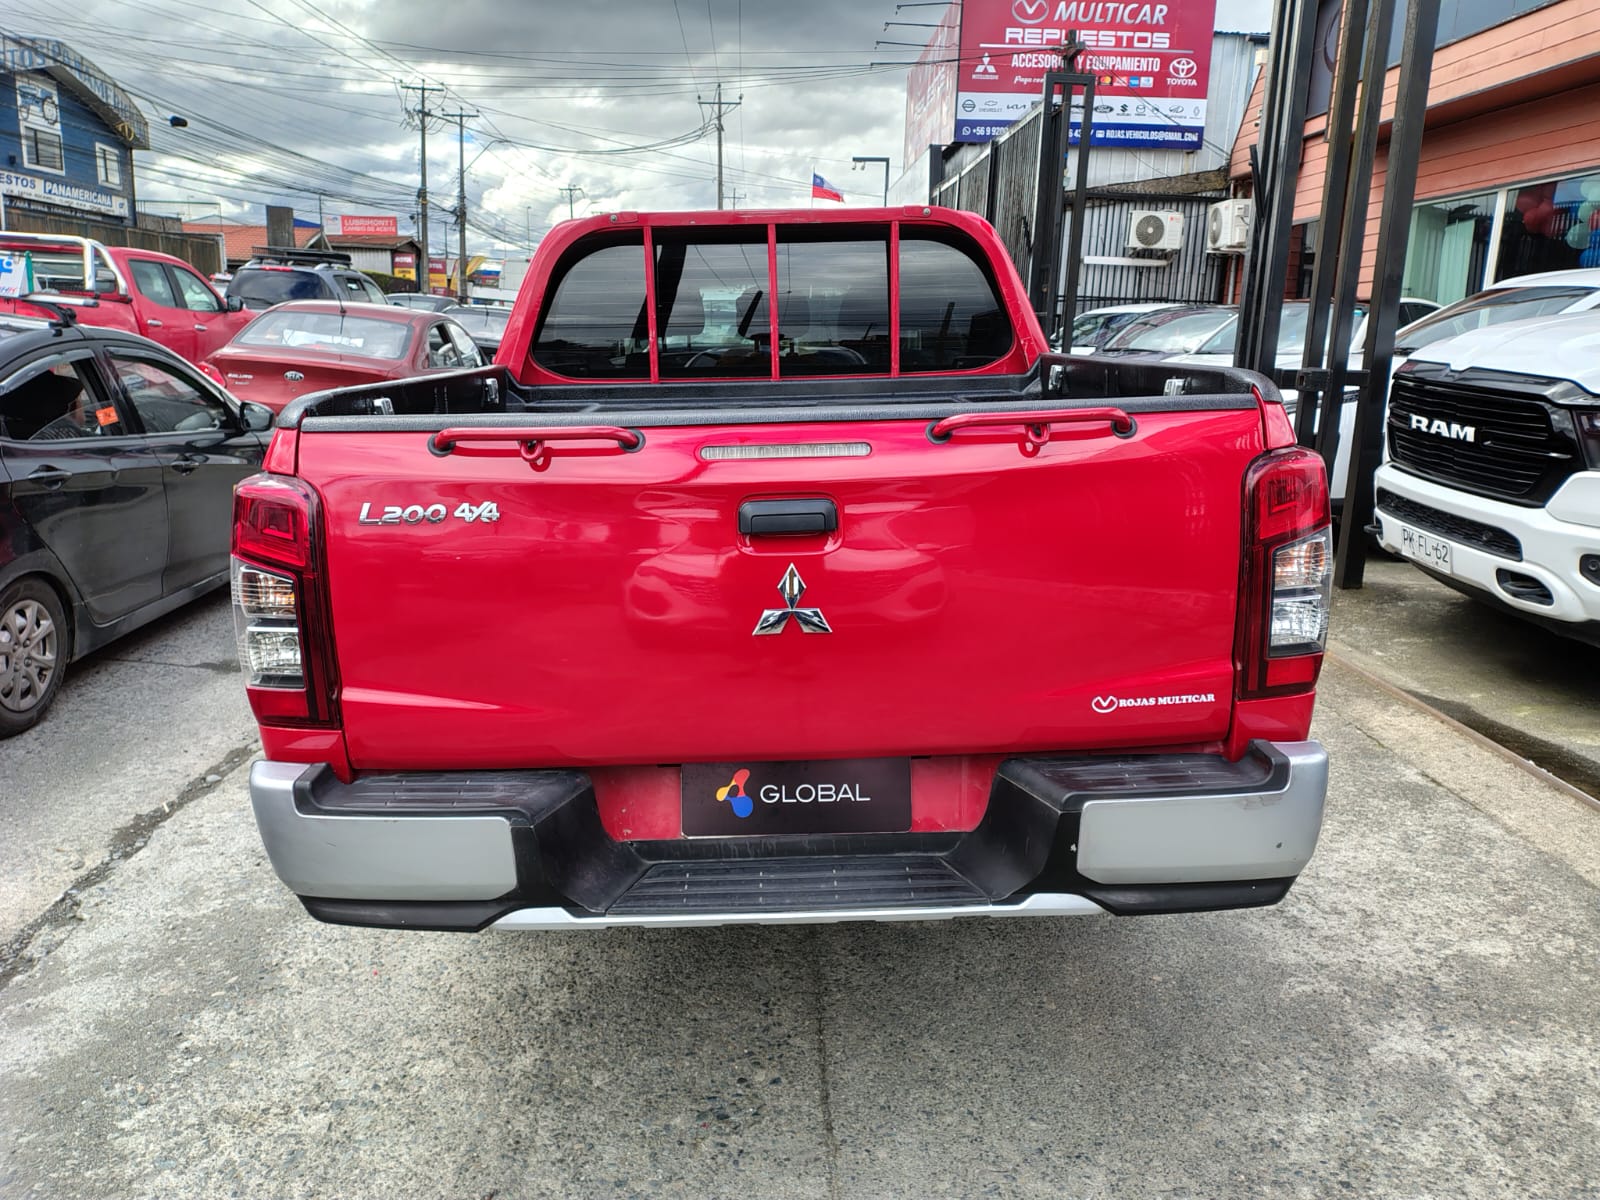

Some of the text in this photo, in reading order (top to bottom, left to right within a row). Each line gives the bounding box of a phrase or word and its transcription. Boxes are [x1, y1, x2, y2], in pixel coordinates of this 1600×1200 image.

[1054, 1, 1168, 25] MULTICAR
[1005, 27, 1170, 48] REPUESTOS
[1011, 54, 1161, 72] ACCESORI Y EQUIPAMIENTO
[1166, 78, 1198, 86] TOYOTA
[986, 127, 991, 136] 9
[46, 181, 112, 206] PANAMERICANA
[1409, 413, 1476, 442] RAM
[1119, 693, 1215, 707] ROJAS MULTICAR
[760, 783, 871, 804] GLOBAL
